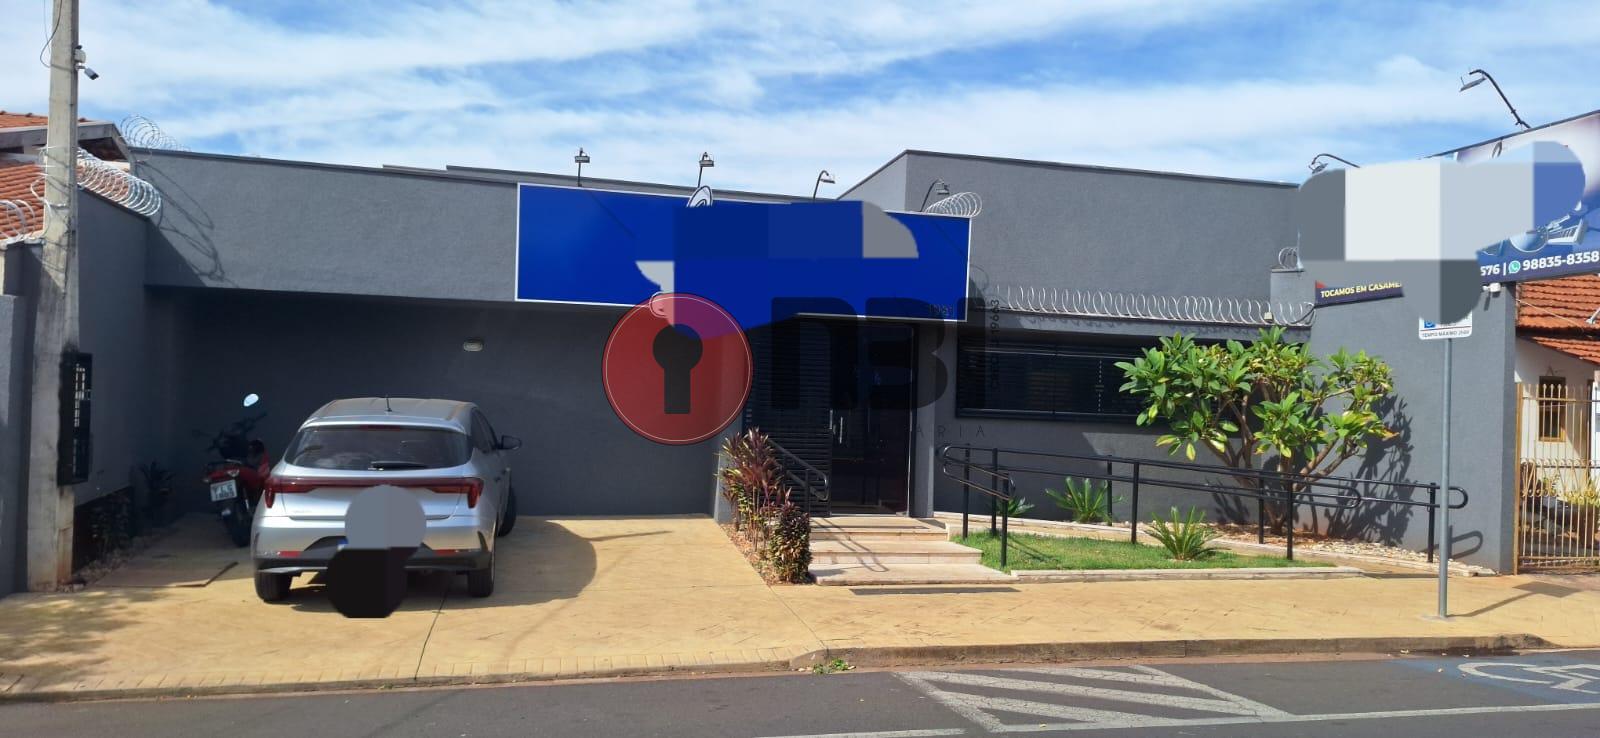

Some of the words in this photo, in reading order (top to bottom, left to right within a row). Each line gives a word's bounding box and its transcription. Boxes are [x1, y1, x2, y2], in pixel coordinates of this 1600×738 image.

[1522, 251, 1600, 272] 98835-8358
[1320, 285, 1355, 298] TOCAMOS
[1355, 285, 1367, 293] EM
